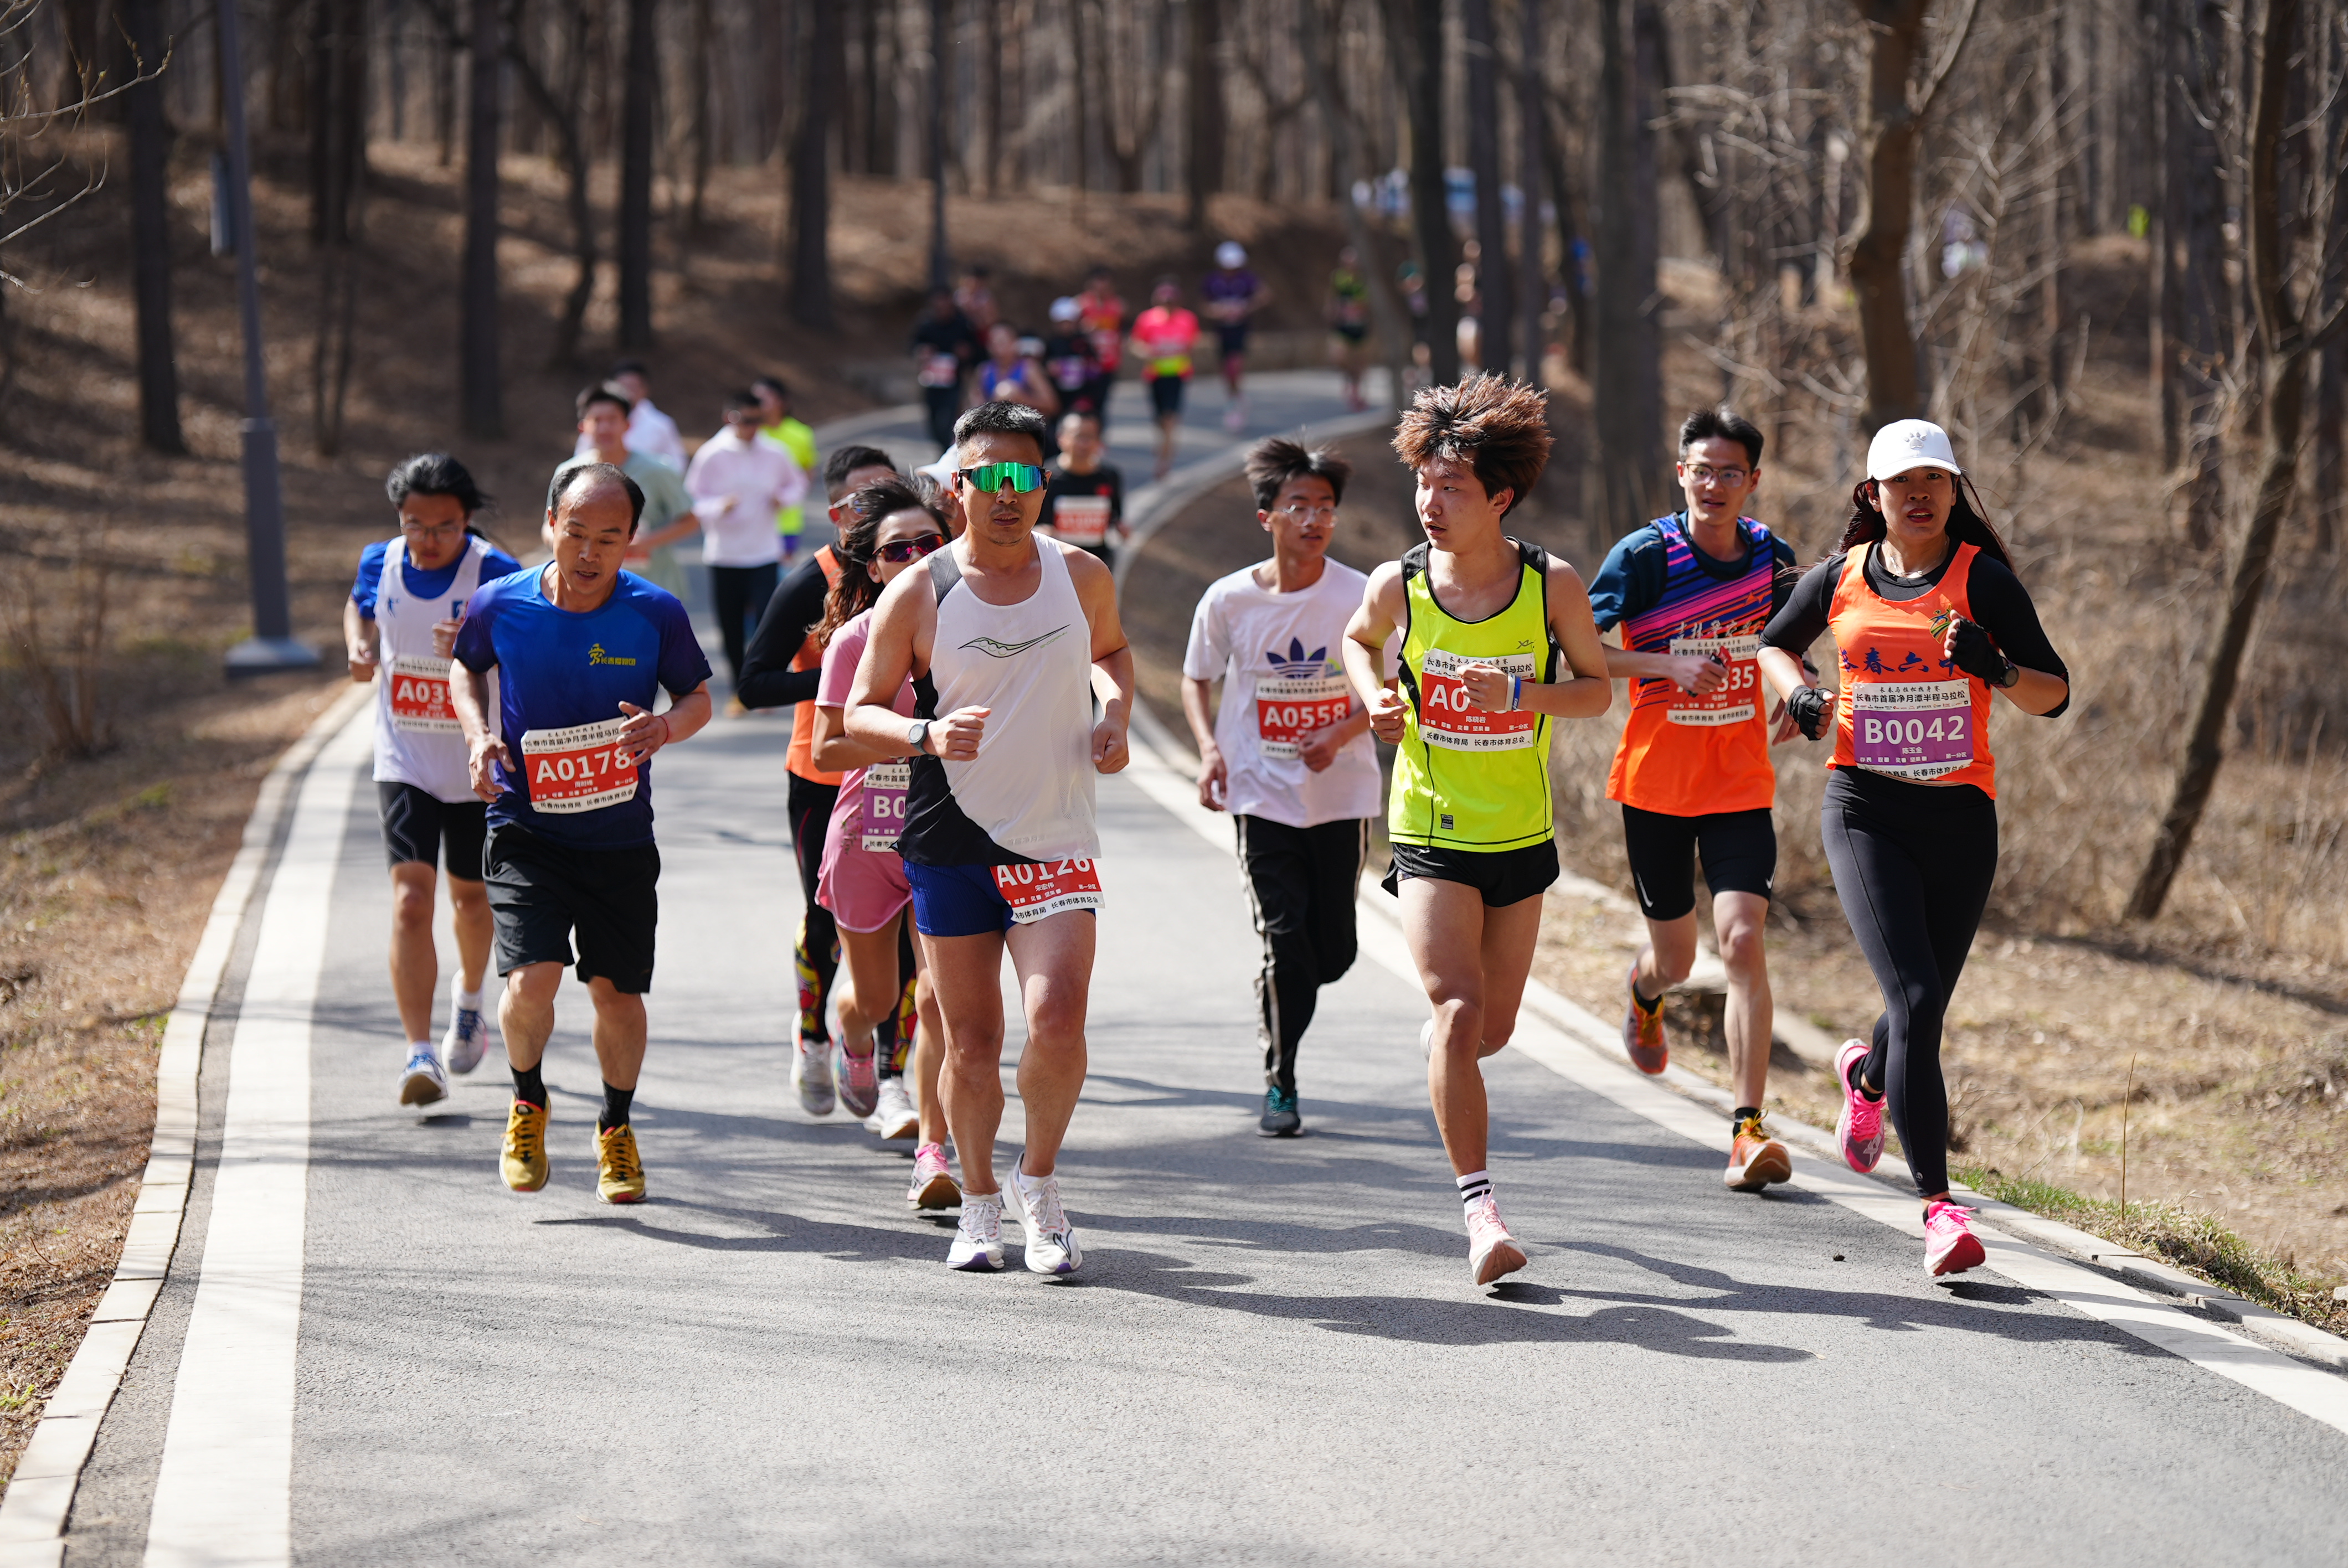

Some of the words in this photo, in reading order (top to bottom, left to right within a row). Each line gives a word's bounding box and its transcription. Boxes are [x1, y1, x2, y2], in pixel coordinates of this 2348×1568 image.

[1856, 690, 1965, 703] 长春市首届净月潭半程马拉松
[1264, 702, 1346, 728] A0558
[526, 727, 621, 747] 长春市首届净月潭半程马拉
[1427, 731, 1468, 746] 长春市体育局
[1474, 736, 1525, 746] 长春市体育总会
[1865, 715, 1965, 745] B0042
[535, 747, 631, 783] A0178
[997, 850, 1090, 888] A0126
[1015, 906, 1047, 919] 市体育局
[1051, 896, 1099, 909] 长春市体育总会
